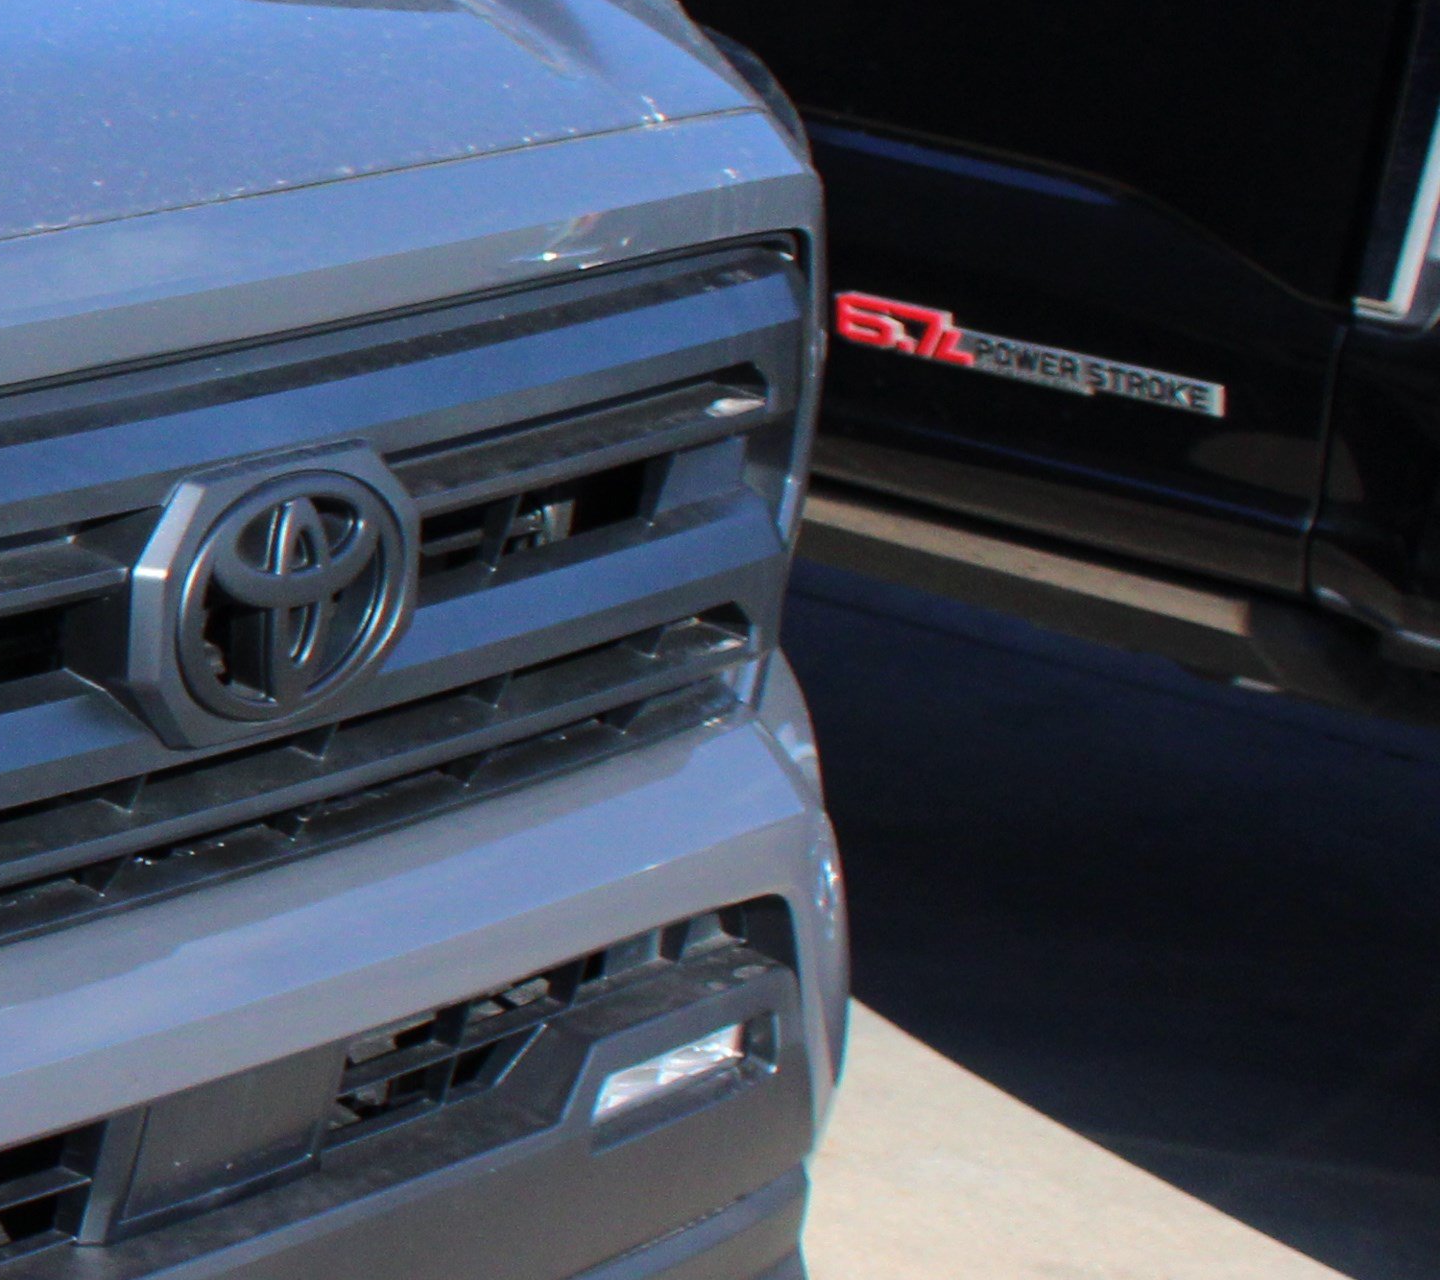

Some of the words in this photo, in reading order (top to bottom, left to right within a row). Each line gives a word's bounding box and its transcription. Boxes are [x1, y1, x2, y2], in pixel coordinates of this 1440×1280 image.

[835, 291, 975, 368] 6.7L
[977, 337, 1078, 382] POWER
[1088, 360, 1212, 411] STROKE
